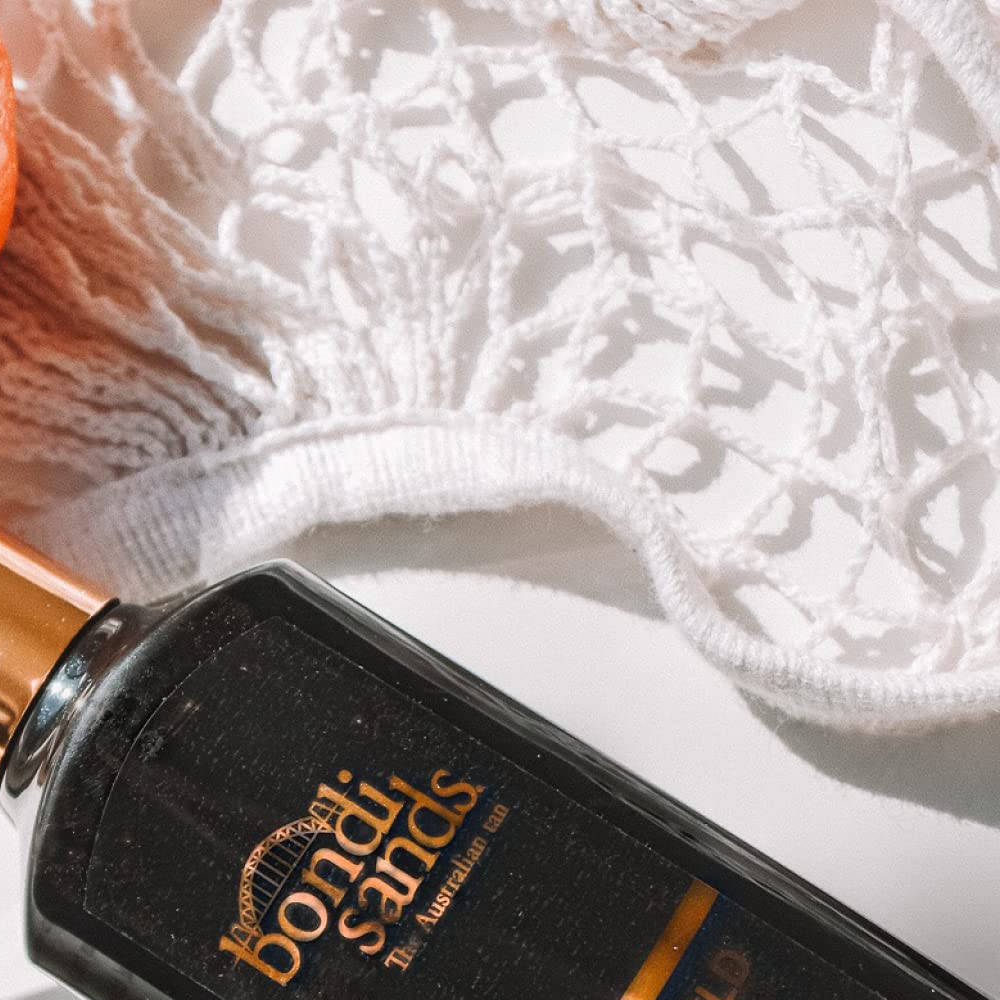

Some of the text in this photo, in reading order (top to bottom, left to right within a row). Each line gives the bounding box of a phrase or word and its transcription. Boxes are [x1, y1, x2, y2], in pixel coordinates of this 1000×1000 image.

[219, 769, 404, 987] bondi
[338, 769, 479, 955] sands
[416, 835, 488, 933] Australian
